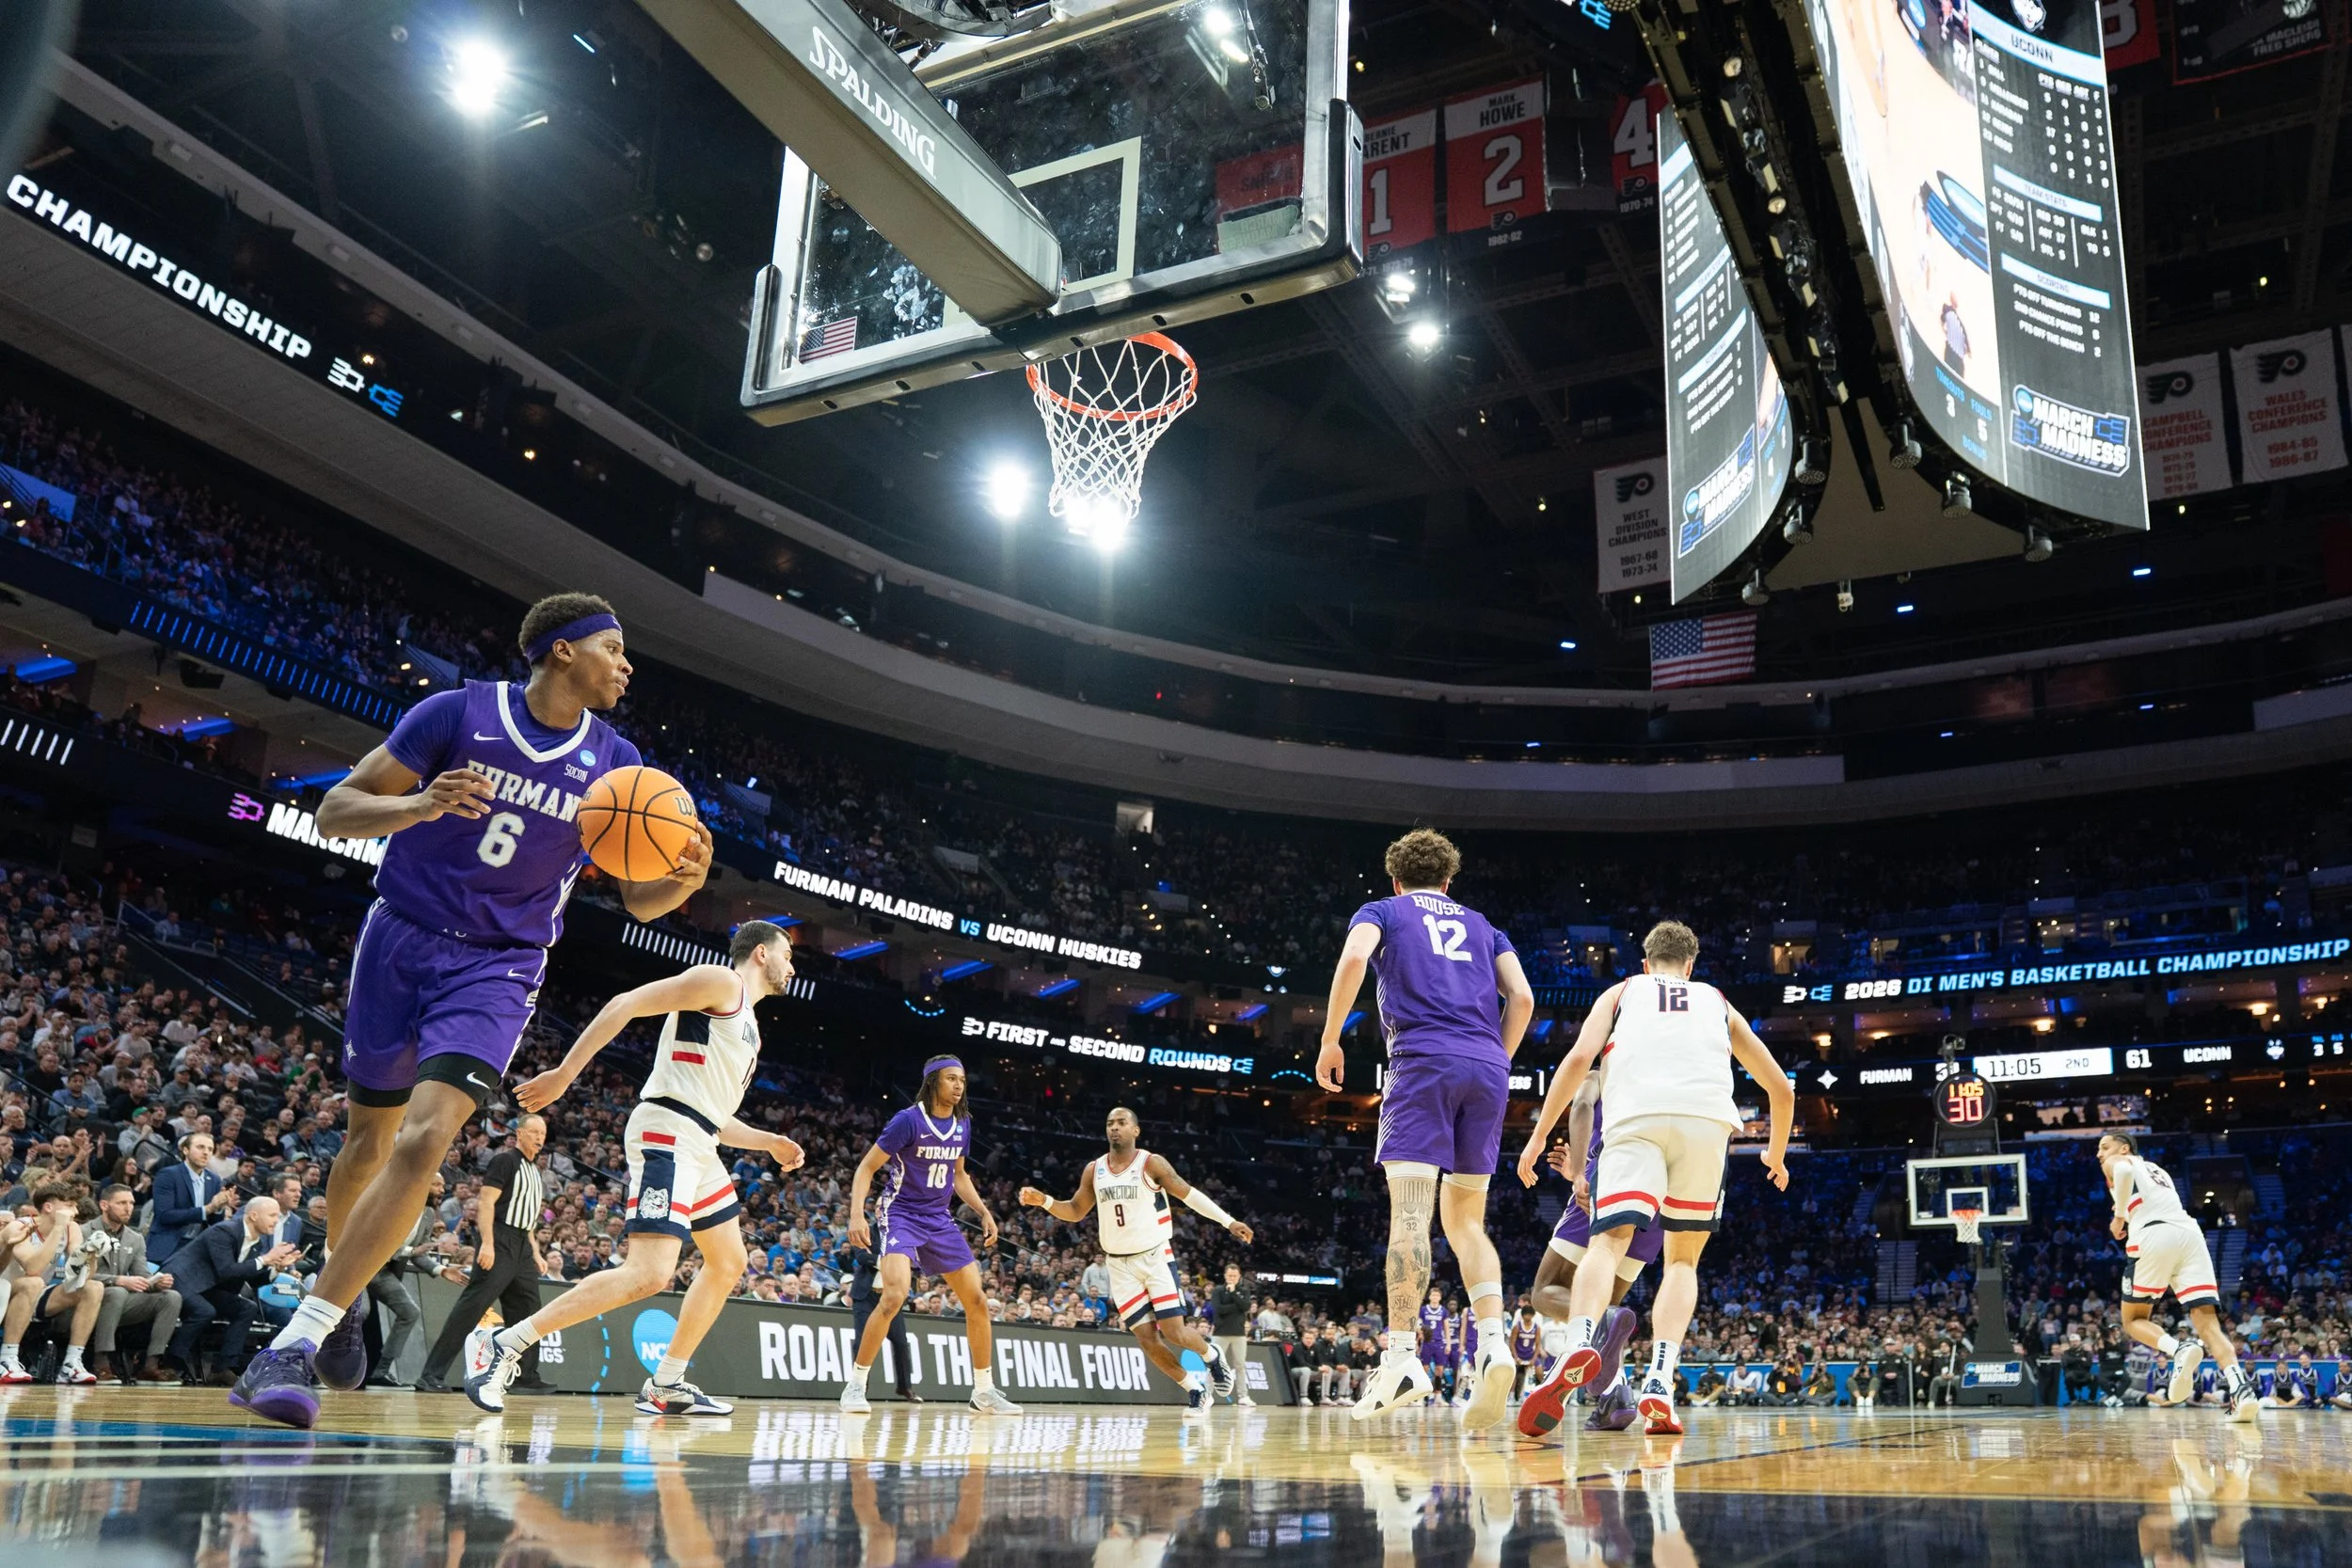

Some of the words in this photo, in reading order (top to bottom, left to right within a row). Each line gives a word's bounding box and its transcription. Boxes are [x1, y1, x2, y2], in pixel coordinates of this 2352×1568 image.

[2011, 34, 2053, 62] UCONN
[809, 25, 938, 180] SPALDING
[1488, 93, 1517, 106] MARK
[1480, 103, 1526, 127] HOWE
[1363, 132, 1411, 159] ARENT
[1613, 98, 1654, 168] 4
[1483, 135, 1523, 207] 2
[1369, 168, 1391, 234] 1
[8, 174, 311, 359] CHAMPIONSHIP
[2248, 398, 2328, 420] CONFERENCE
[2265, 389, 2307, 406] WALES
[1978, 419, 1988, 442] 5
[2032, 396, 2095, 438] MARCH
[2143, 409, 2204, 429] CAMPBELL
[2251, 410, 2328, 433] CHAMPIONS
[2041, 423, 2127, 468] MADNESS
[1615, 519, 1659, 536] DIVISION
[1623, 508, 1650, 522] WEST
[1608, 528, 1667, 547] CHAMPIONS
[564, 764, 588, 784] SOCON
[476, 811, 526, 868] 6
[773, 861, 857, 902] FURMAN
[859, 888, 954, 930] PALADINS
[960, 918, 981, 936] VS
[986, 922, 1056, 953] UCONN
[1058, 938, 1142, 970] HUSKIES
[1411, 895, 1466, 916] HOUSE
[1422, 914, 1472, 962] 12
[1844, 979, 1901, 1000] 2026
[1907, 978, 1933, 995] DI
[1939, 970, 2005, 991] MEN'S
[2010, 958, 2151, 988] BASKETBALL
[2156, 939, 2350, 974] CHAMPIONSHIP
[1658, 984, 1688, 1012] 12
[986, 1021, 1049, 1048] FIRST
[1068, 1035, 1145, 1063] SECOND
[1148, 1048, 1232, 1072] ROUNDS
[1860, 1068, 1913, 1085] FURMAN
[1990, 1058, 2042, 1078] 11:05
[2065, 1057, 2090, 1069] 2ND
[2125, 1049, 2153, 1069] 61
[2183, 1046, 2232, 1063] UCONN
[1949, 1081, 1984, 1099] 11:05
[1947, 1096, 1983, 1123] 30
[927, 1163, 948, 1189] 10
[1099, 1185, 1137, 1203] CONNECTICUT
[1114, 1204, 1125, 1227] 9
[927, 1334, 974, 1386] TH
[996, 1338, 1079, 1389] FINAL
[1080, 1344, 1152, 1391] FOUR
